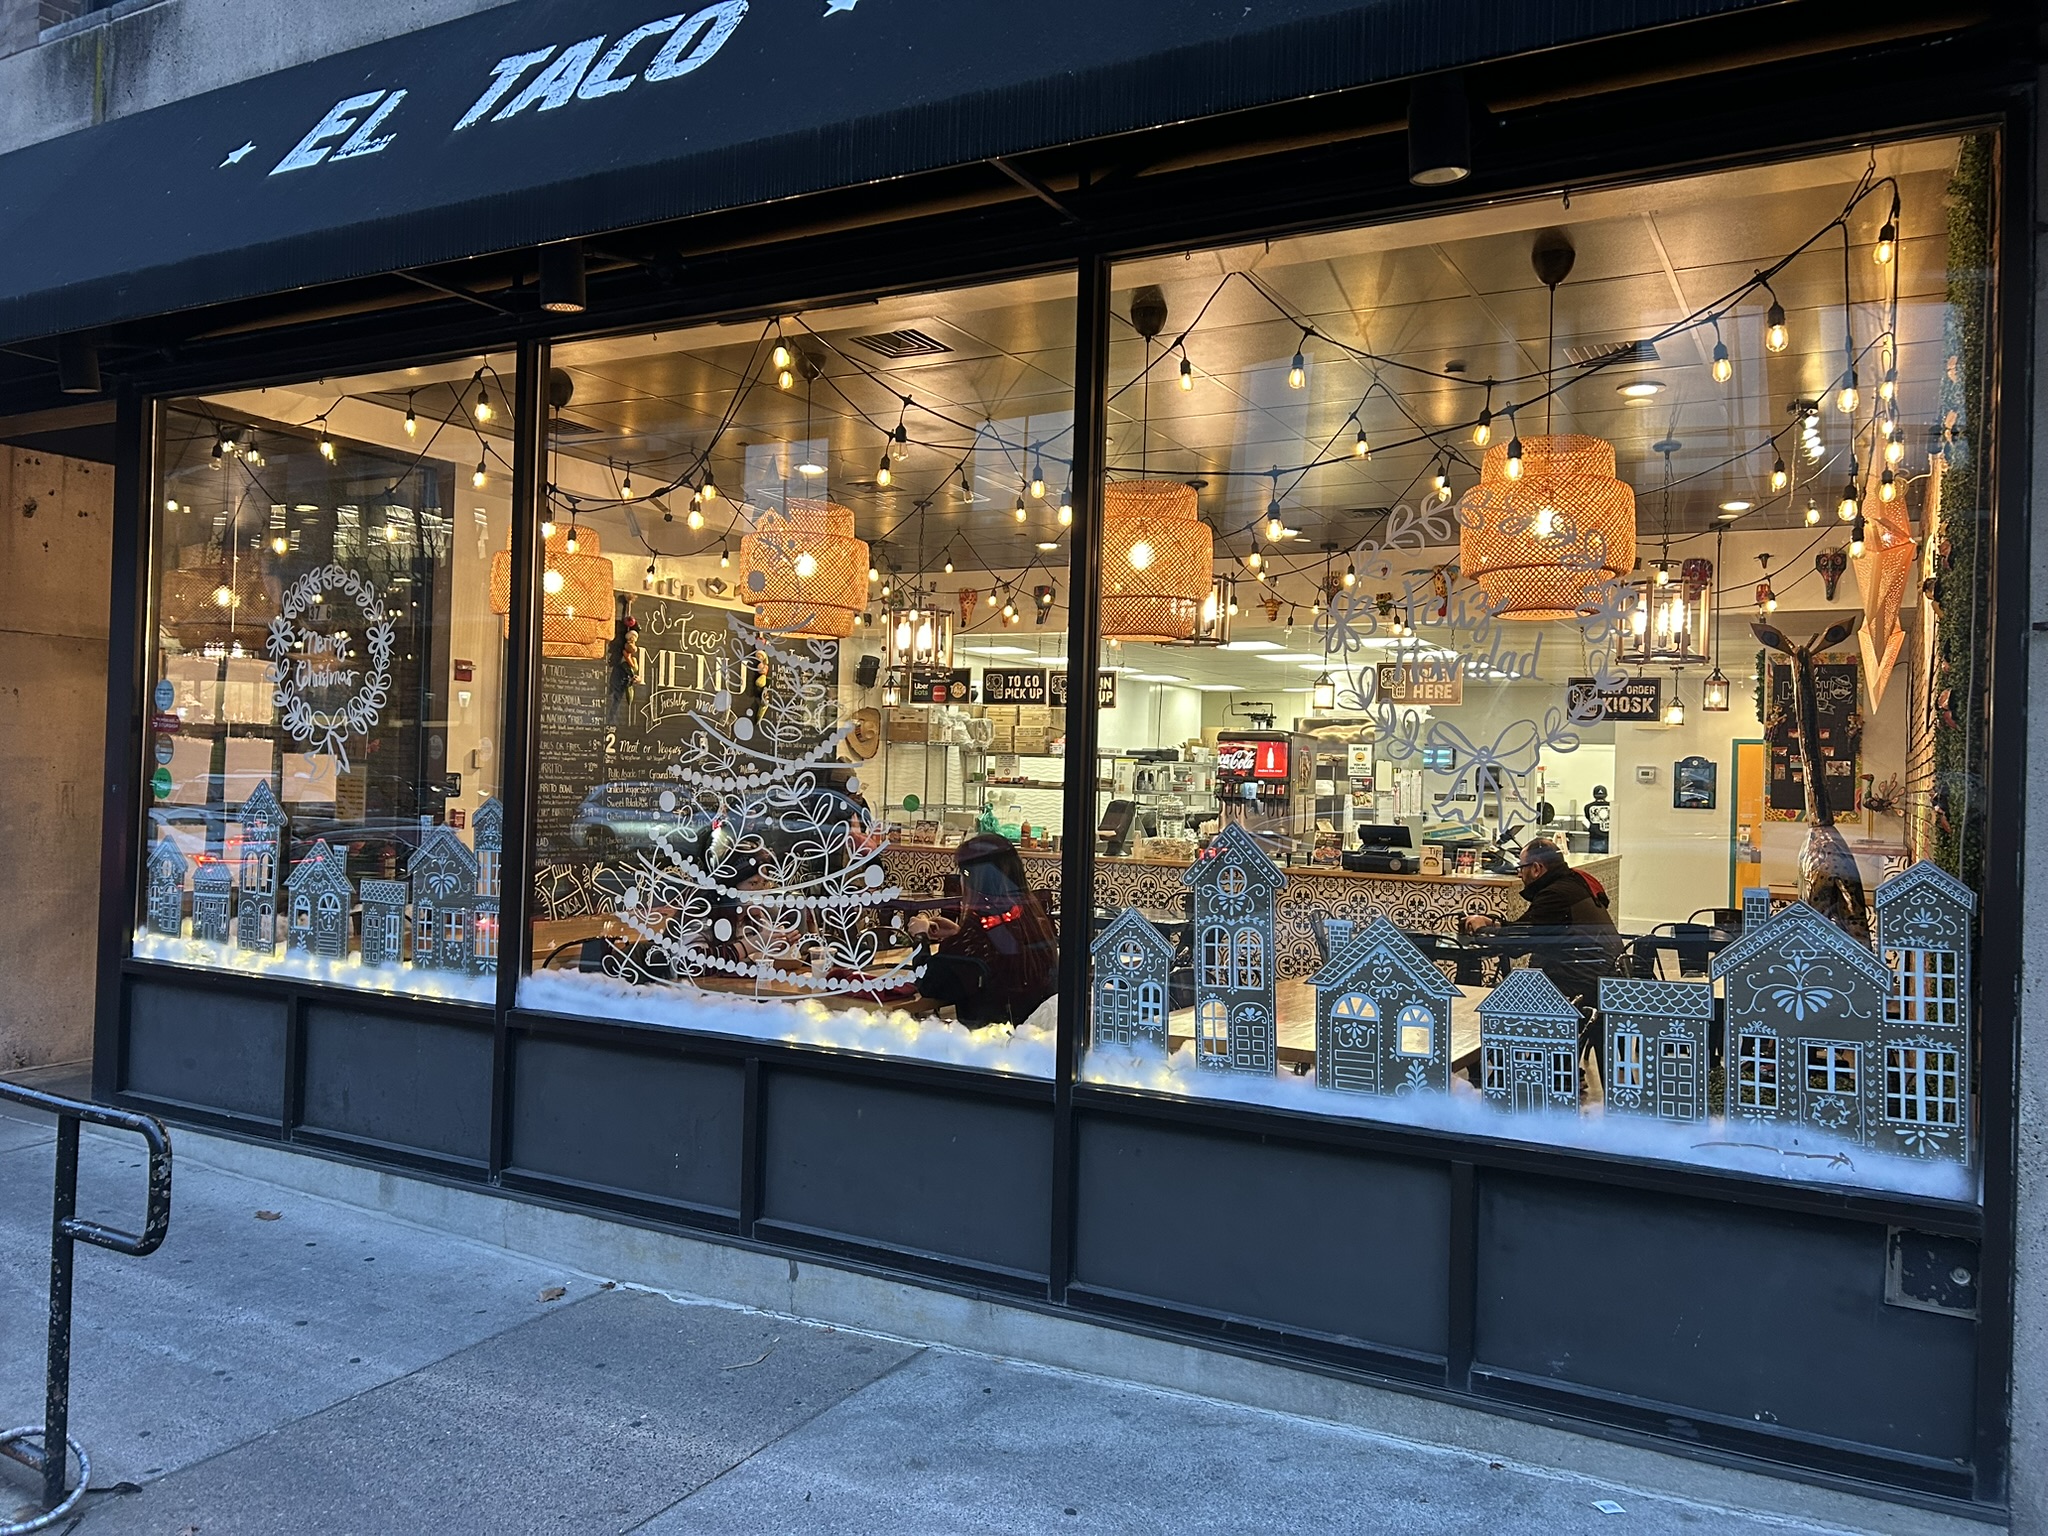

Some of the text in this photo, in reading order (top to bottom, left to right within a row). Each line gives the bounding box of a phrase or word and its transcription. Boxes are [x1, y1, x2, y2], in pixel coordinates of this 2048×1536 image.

[268, 0, 749, 176] EL TACO
[651, 600, 672, 635] El
[1393, 570, 1506, 643] Feliz
[298, 627, 352, 662] Merry
[674, 613, 723, 654] Taco
[1386, 631, 1544, 685] Navidad
[296, 659, 360, 691] Christmas
[638, 647, 748, 694] MENU
[1007, 675, 1039, 687] TO GO
[1005, 688, 1043, 699] PICK UP
[1098, 691, 1113, 703] UP
[1413, 684, 1453, 699] HERE
[1626, 685, 1656, 695] ORDER
[659, 692, 690, 714] freshly
[1603, 697, 1654, 713] KIOSK
[605, 734, 616, 753] 2
[619, 740, 640, 753] Meat
[643, 745, 653, 754] or
[558, 896, 582, 919] SALSA
